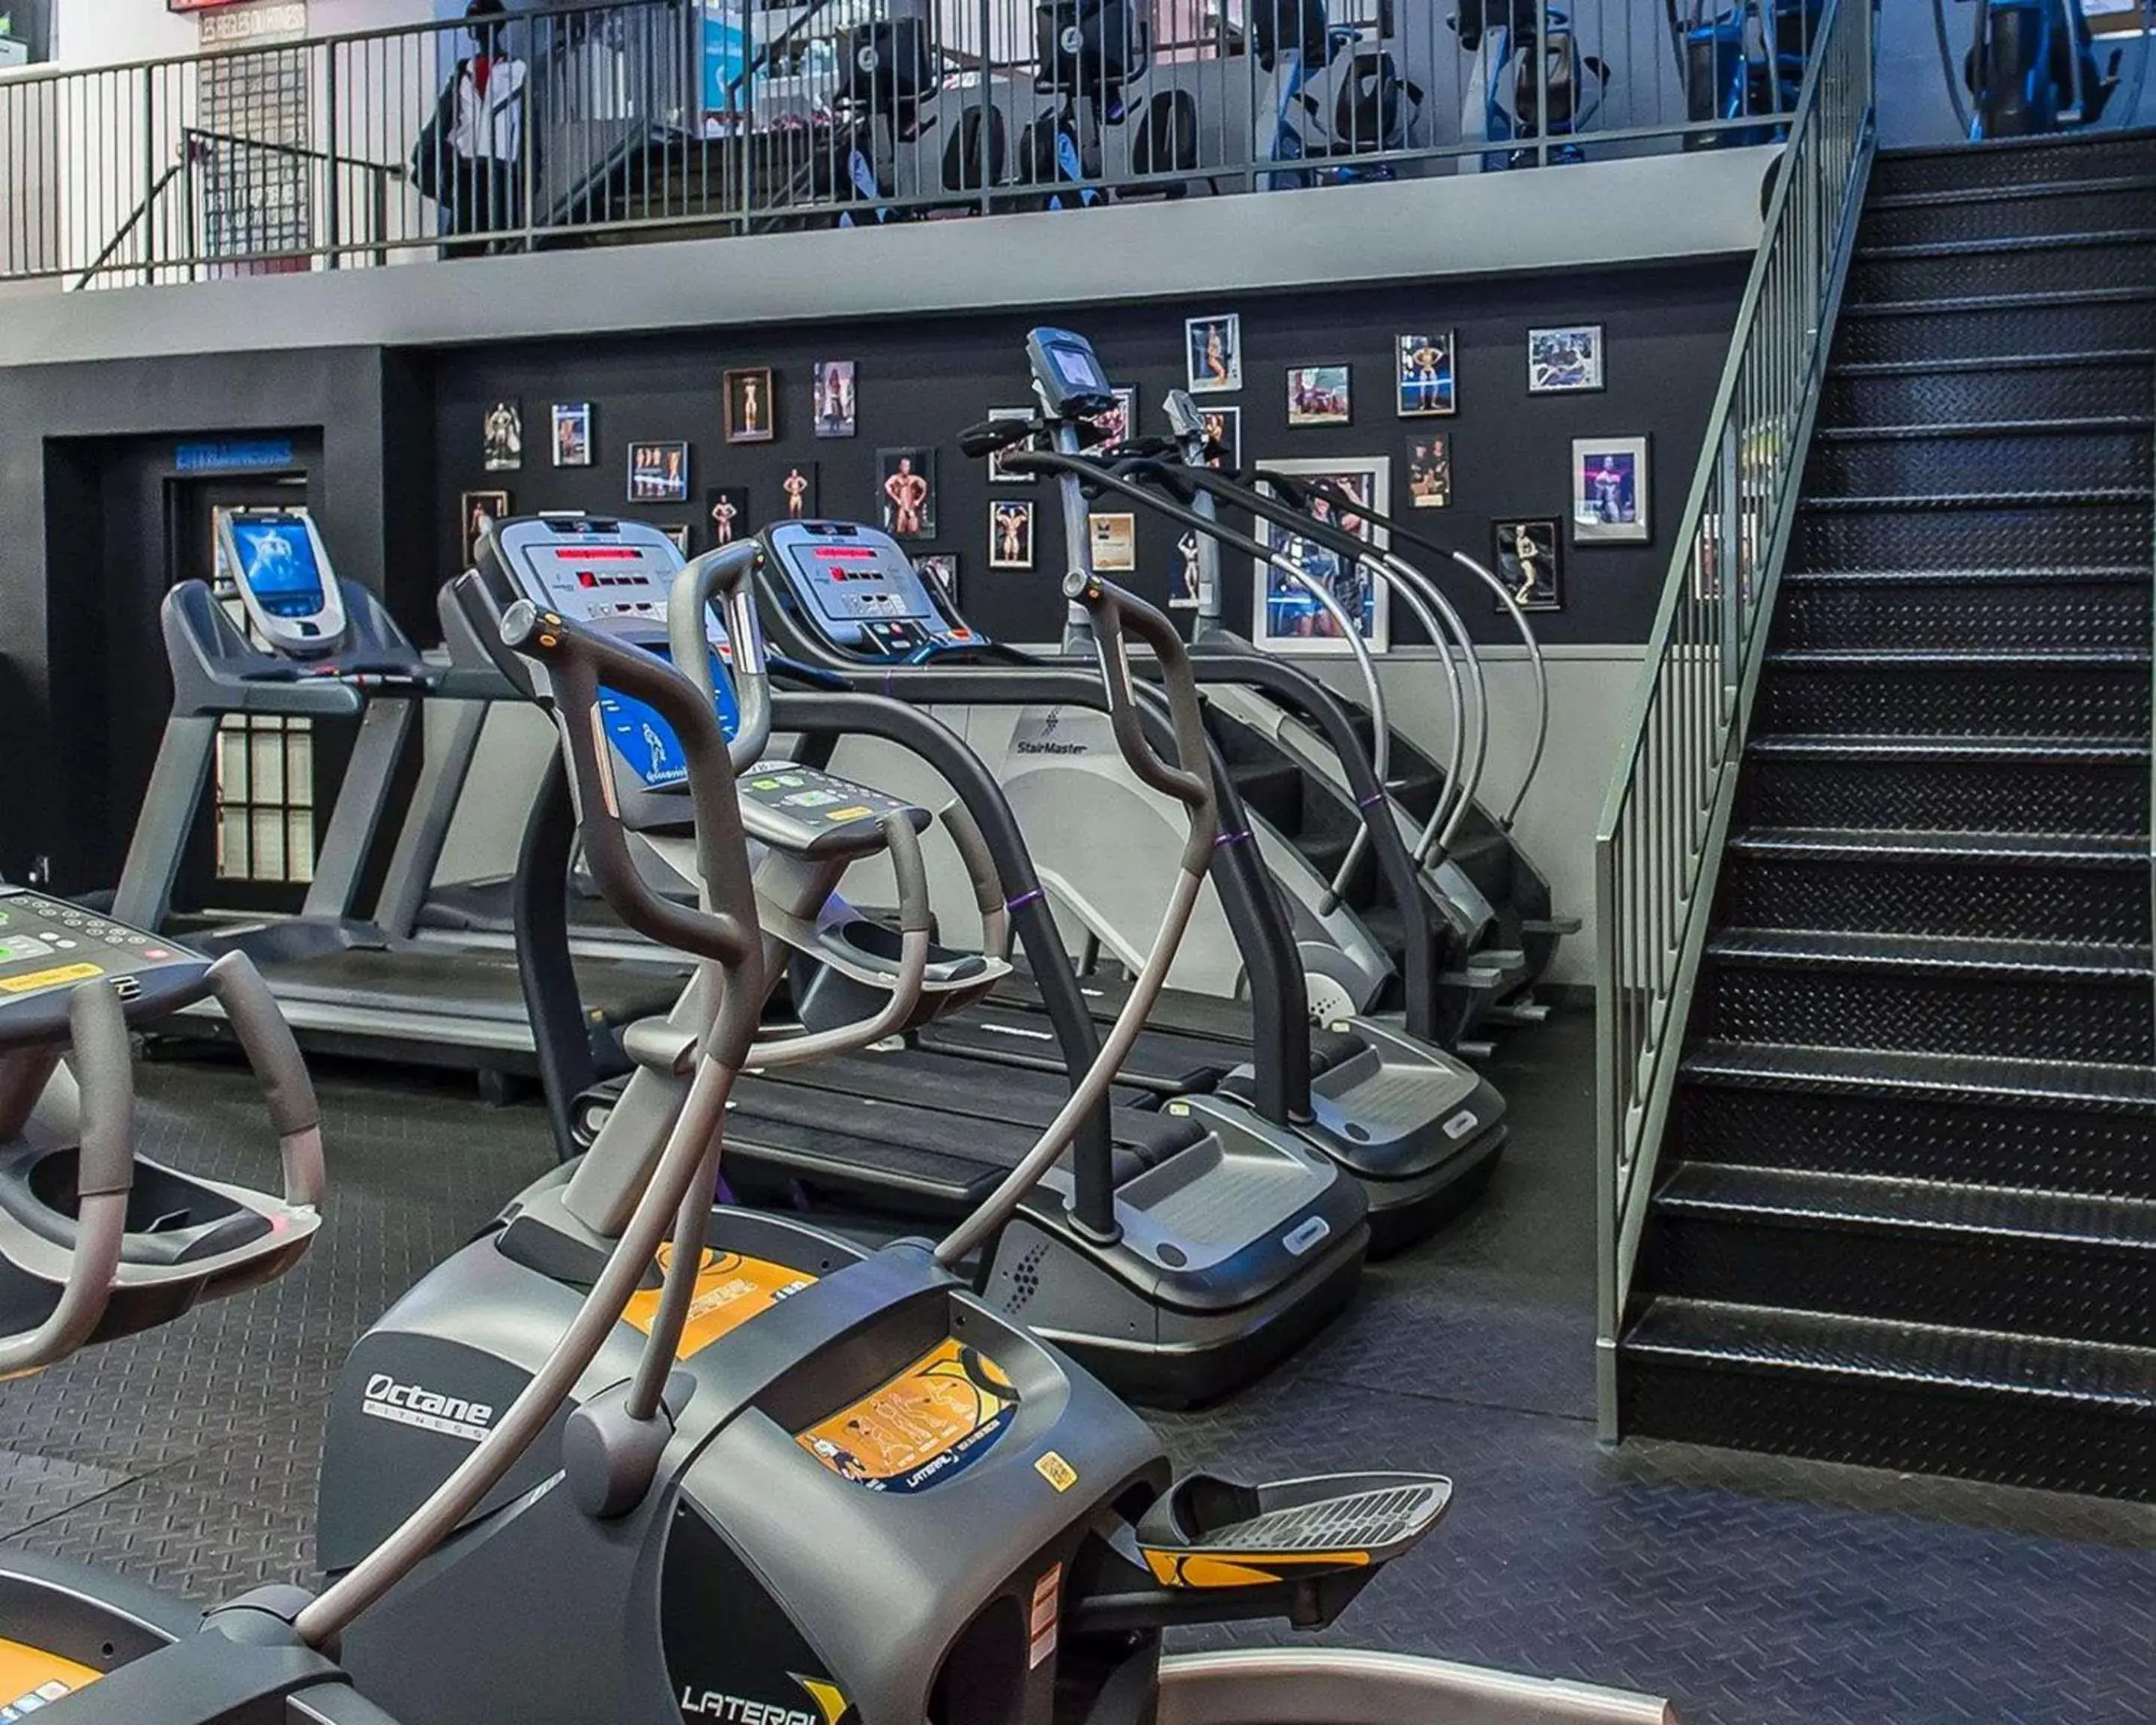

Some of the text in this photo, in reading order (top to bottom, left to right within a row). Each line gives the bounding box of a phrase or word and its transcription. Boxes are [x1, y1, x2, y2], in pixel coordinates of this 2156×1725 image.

[1017, 740, 1088, 755] StairMaster
[365, 1373, 493, 1426] Octane
[367, 1402, 484, 1439] FITNESS
